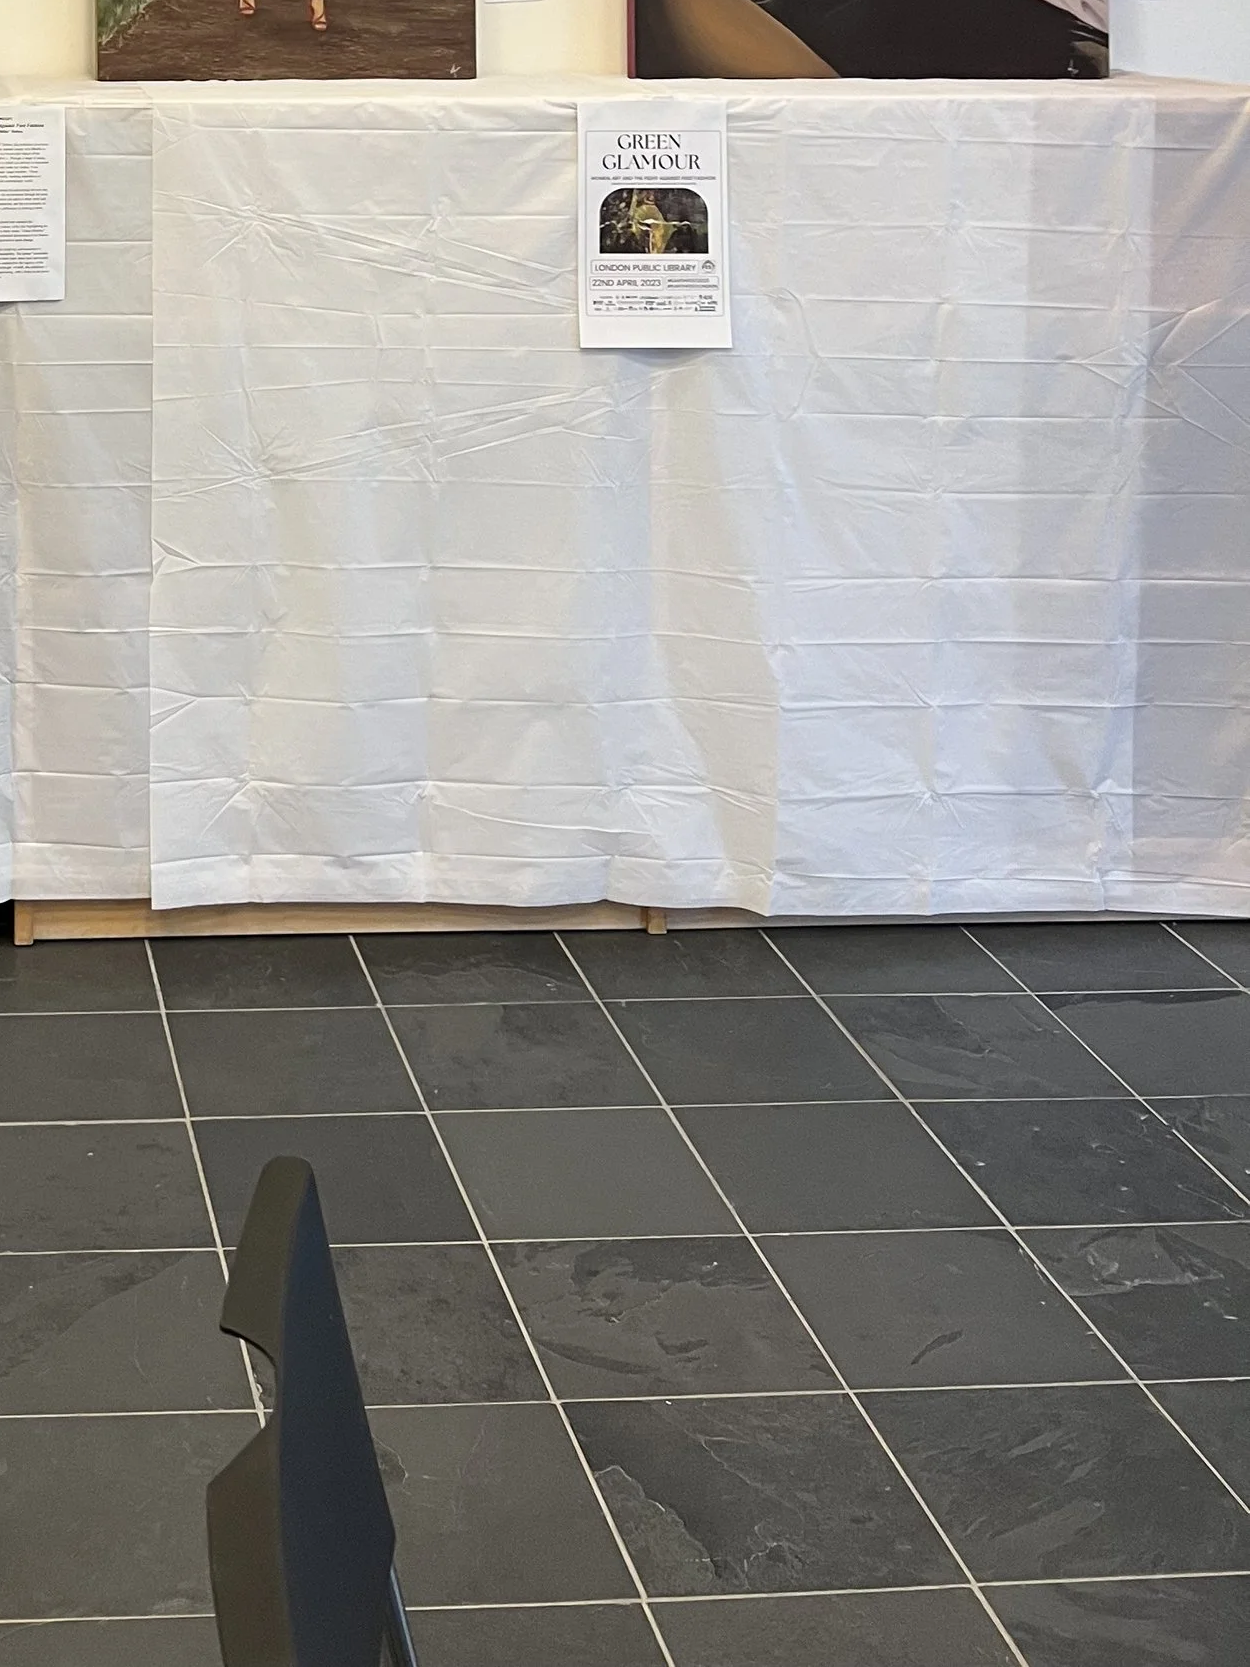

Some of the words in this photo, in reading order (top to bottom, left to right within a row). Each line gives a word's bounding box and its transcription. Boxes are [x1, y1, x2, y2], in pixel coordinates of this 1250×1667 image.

[617, 134, 681, 150] GREEN
[602, 154, 701, 170] GLAMOUR
[594, 264, 631, 272] LONDON
[632, 264, 661, 272] PUBLIC
[663, 264, 696, 272] LIBRARY
[592, 279, 614, 287] 22ND
[616, 279, 638, 287] APRIL
[640, 279, 661, 287] 2023
